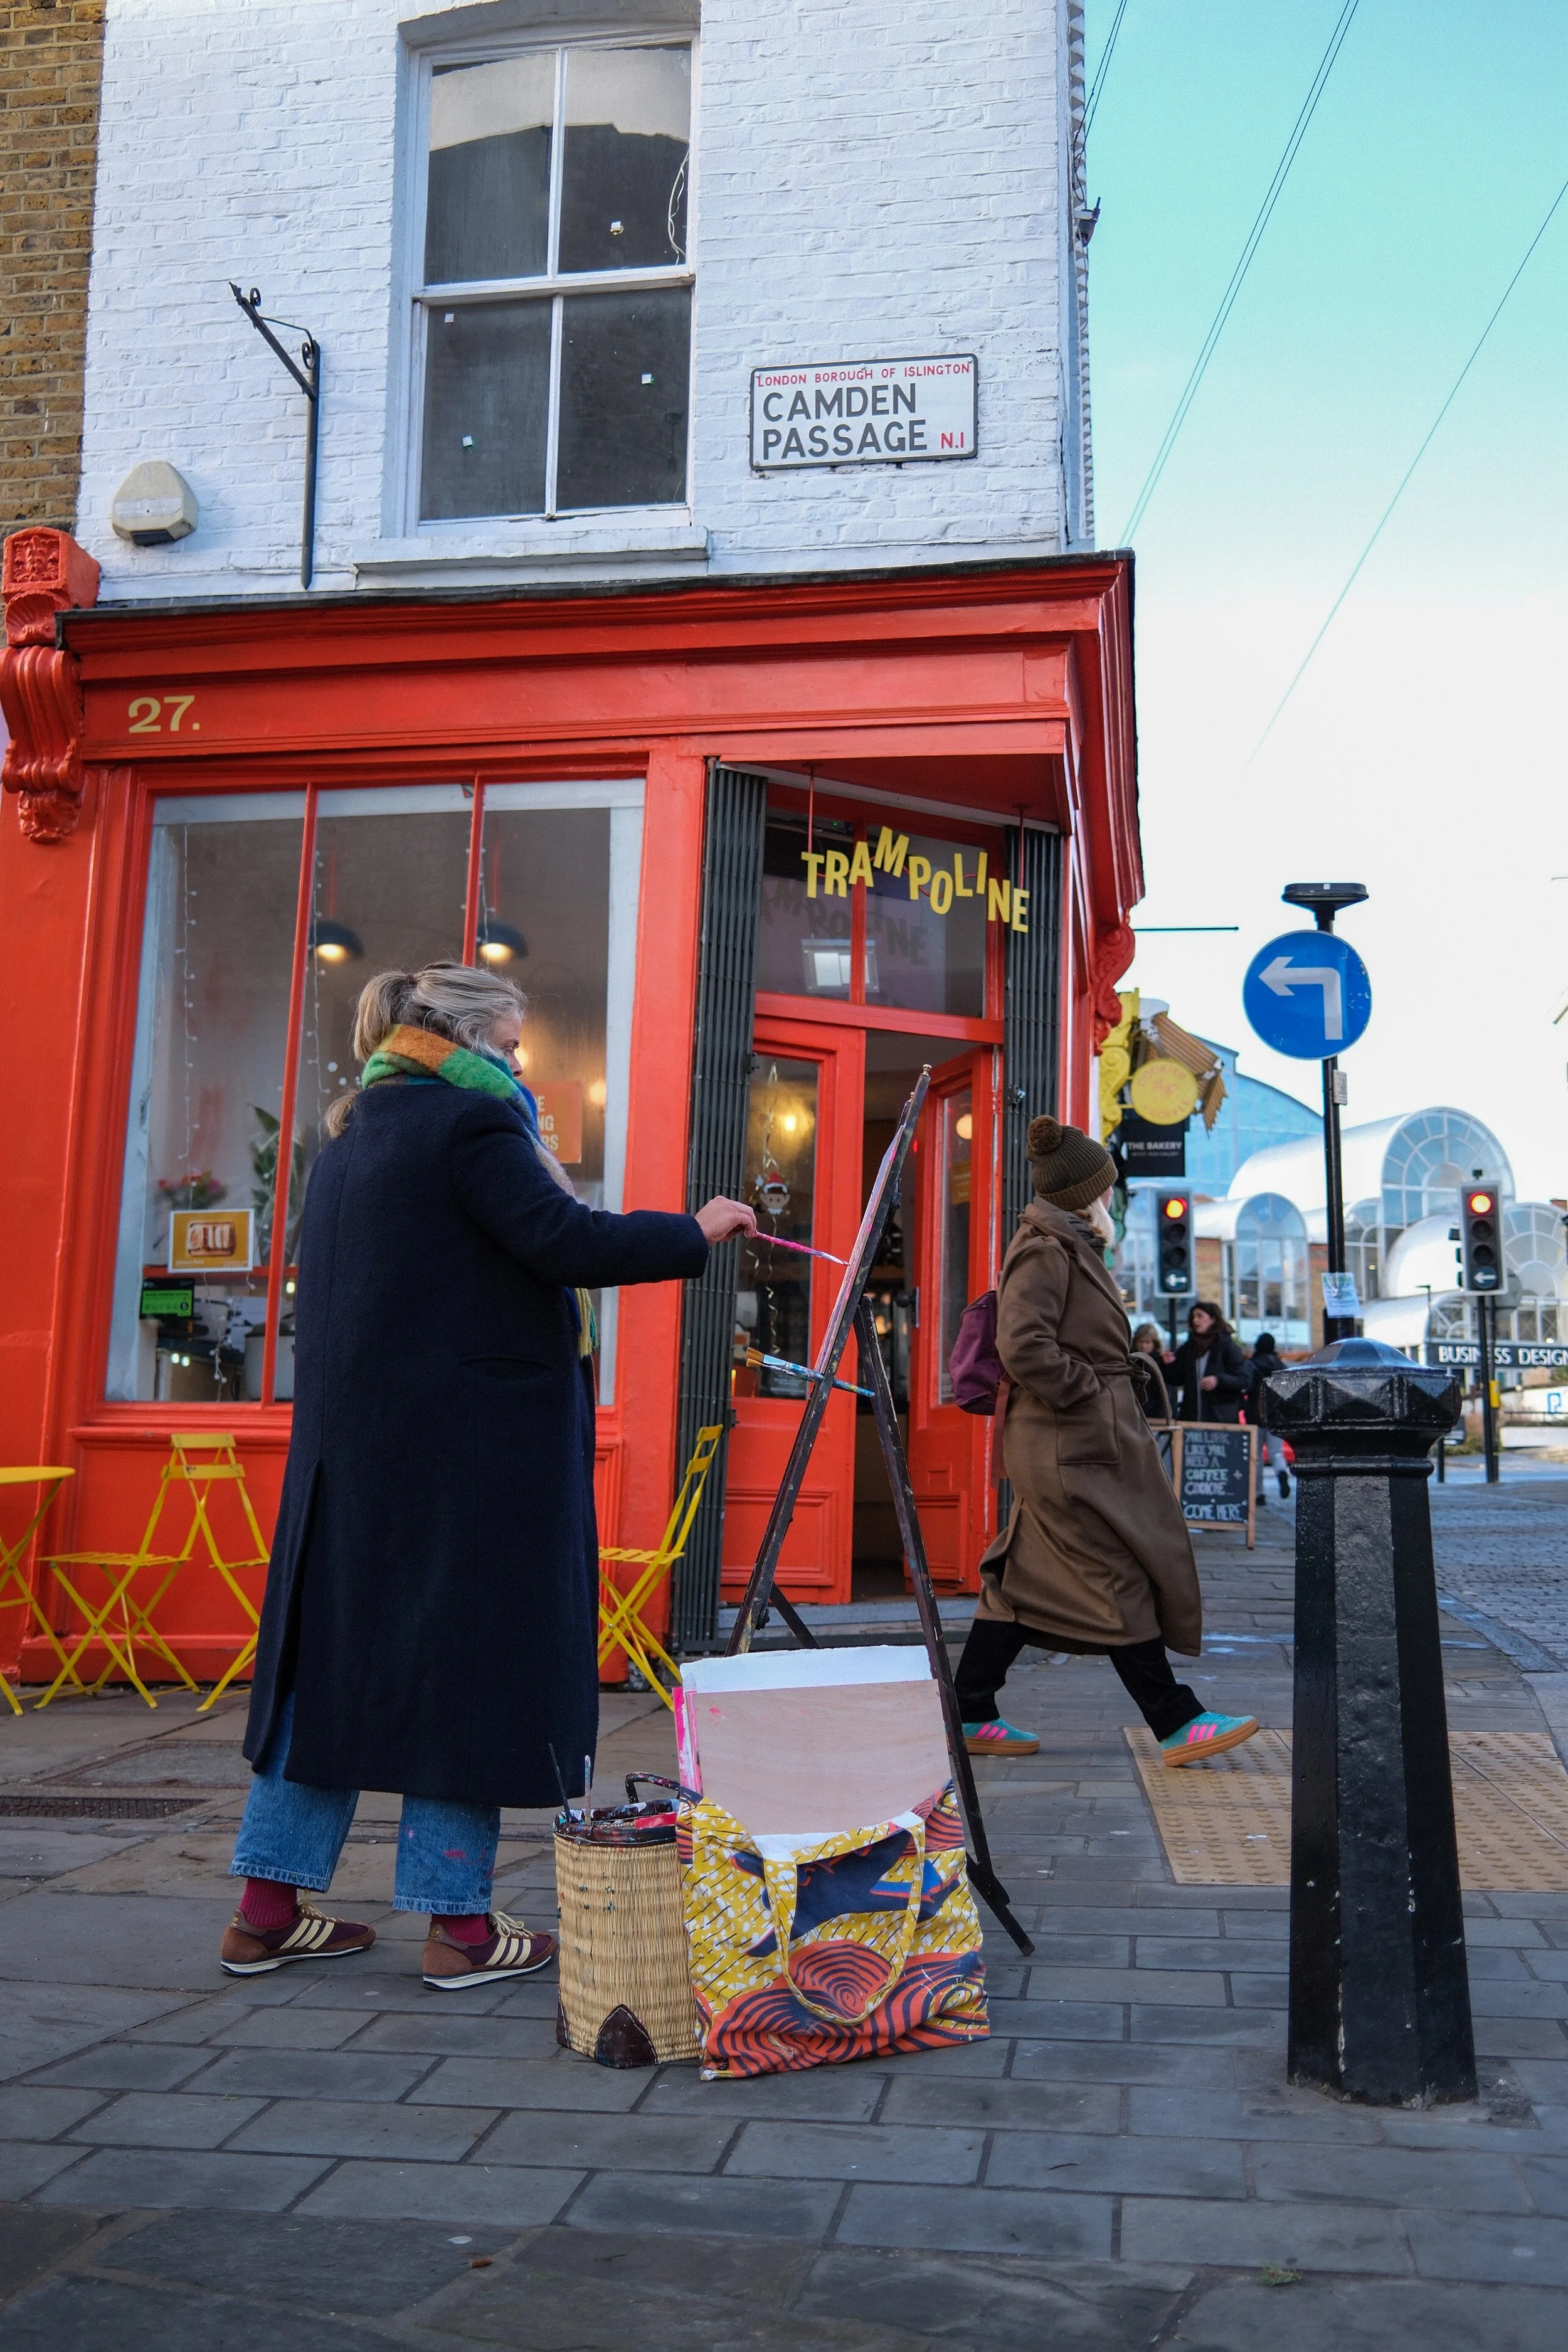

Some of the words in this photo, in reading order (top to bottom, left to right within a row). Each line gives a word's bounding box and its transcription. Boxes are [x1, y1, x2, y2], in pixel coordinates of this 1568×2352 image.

[757, 374, 807, 387] LONDON
[815, 369, 873, 383] BOROUGH
[881, 368, 896, 378] OF
[904, 363, 970, 378] ISLINGTON
[763, 383, 916, 422] CAMDEN
[763, 419, 928, 460] PASSAGE
[801, 825, 1030, 933] TRAMPOLINE
[1128, 1142, 1145, 1150] THE
[1147, 1141, 1182, 1150] BAKERY
[1438, 1345, 1513, 1365] BUSINSS
[1185, 1431, 1203, 1443] YOU
[1204, 1432, 1230, 1445] LOOK
[1184, 1444, 1207, 1455] LIKE
[1207, 1444, 1227, 1458] YOU
[1184, 1456, 1209, 1467] NEED
[1210, 1456, 1221, 1468] A
[1184, 1504, 1216, 1520] COME
[1217, 1503, 1243, 1522] HERE
